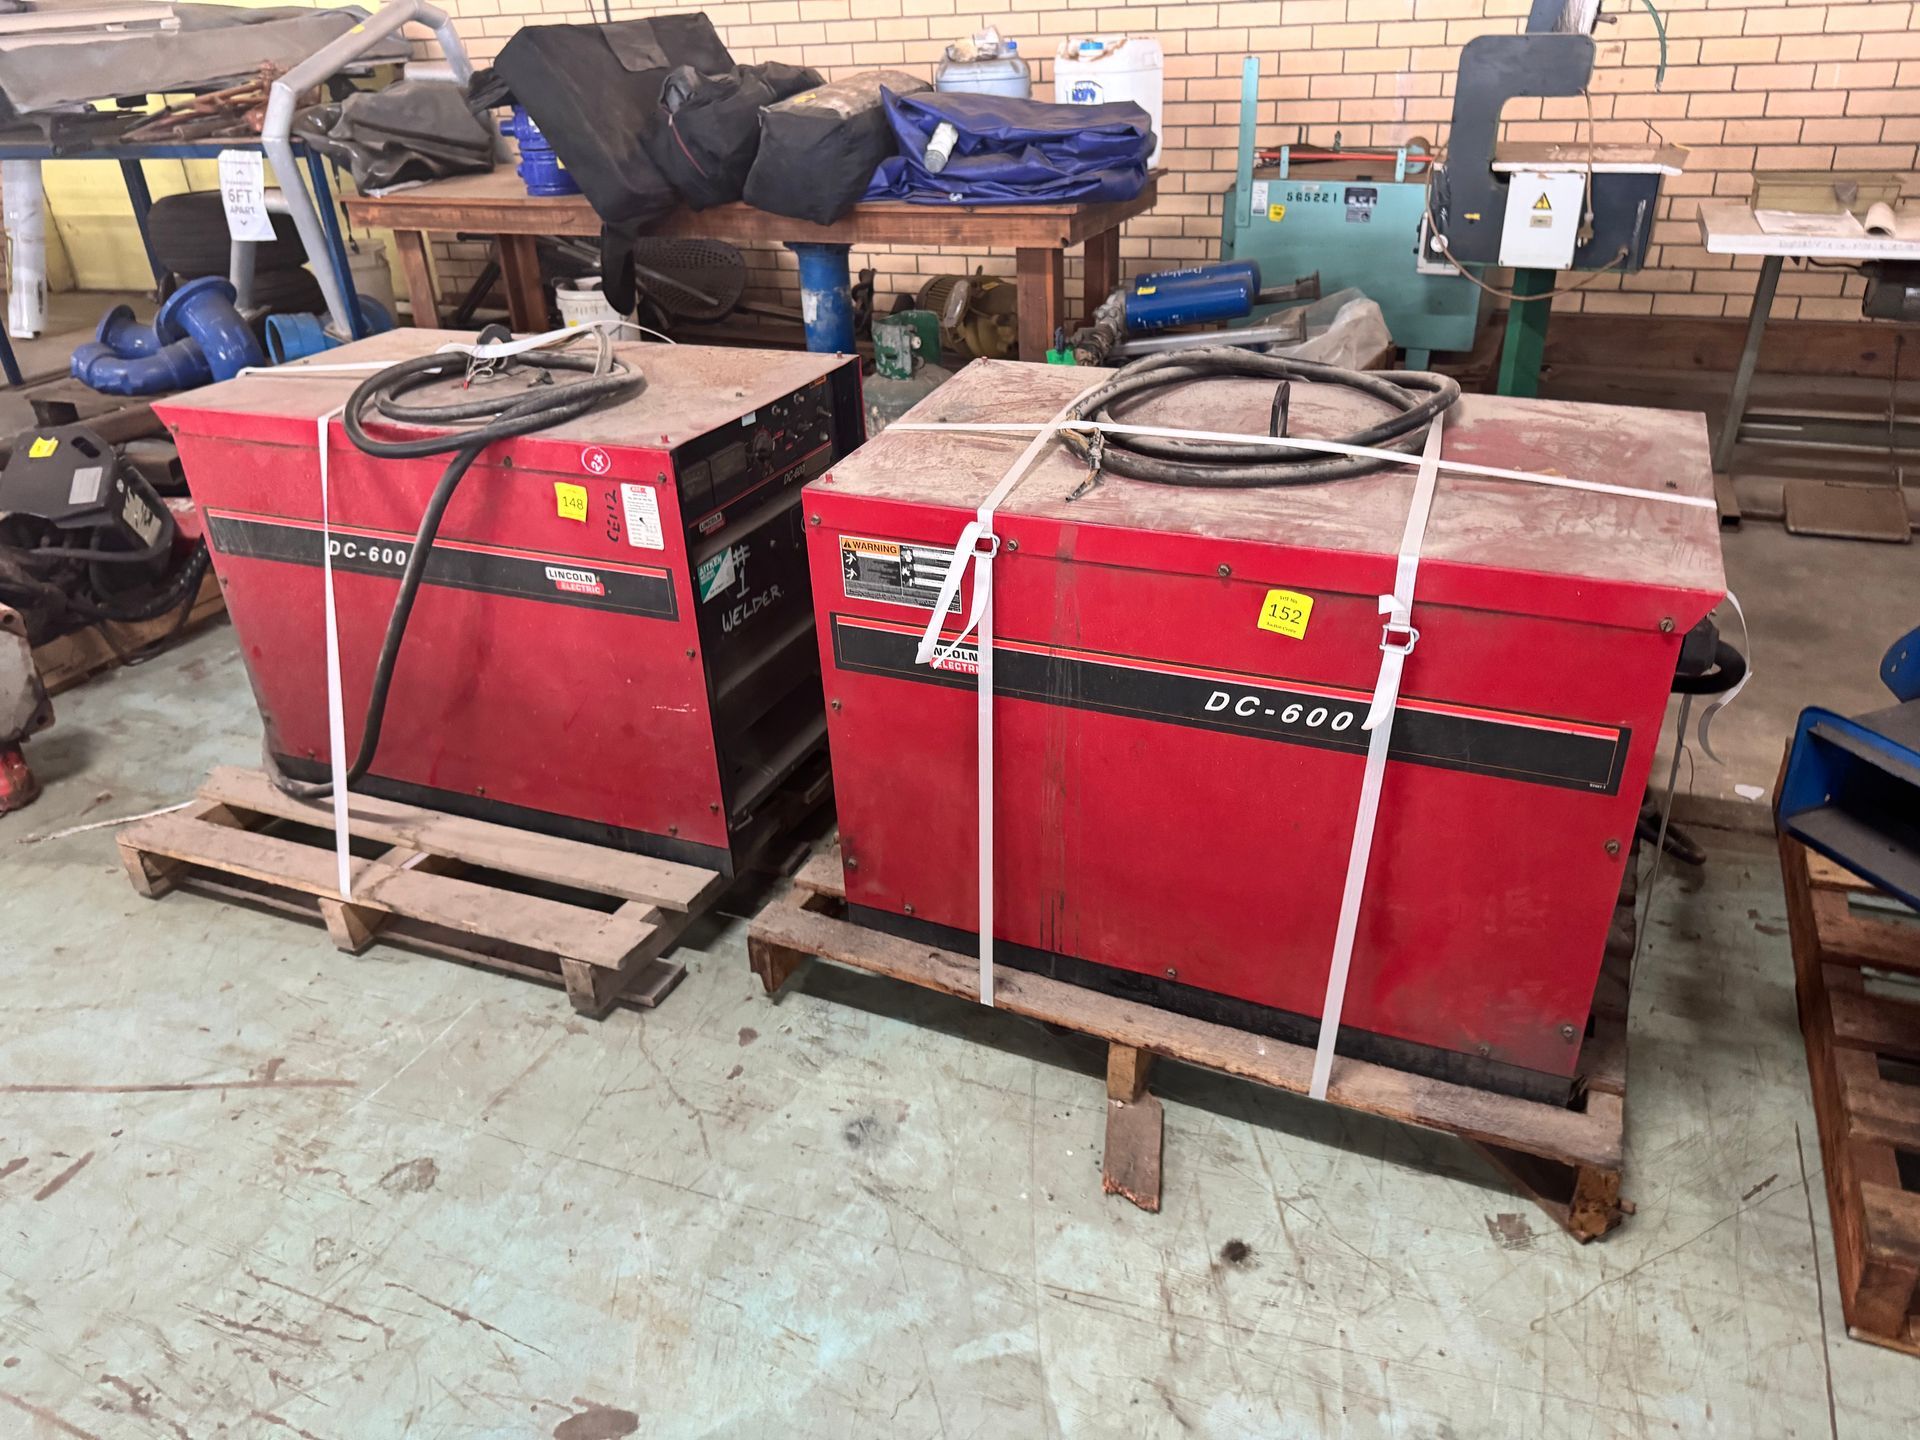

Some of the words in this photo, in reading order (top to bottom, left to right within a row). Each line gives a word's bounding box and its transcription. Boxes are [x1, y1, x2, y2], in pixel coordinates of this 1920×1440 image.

[228, 189, 252, 203] 6FT
[230, 206, 255, 214] APART
[563, 496, 584, 511] 148
[329, 539, 407, 566] DC-600
[852, 540, 897, 554] WARNING
[548, 569, 593, 583] LINCOLN
[560, 581, 601, 594] ELECTRIC
[1269, 604, 1302, 624] 152
[1205, 690, 1354, 731] DC-600
